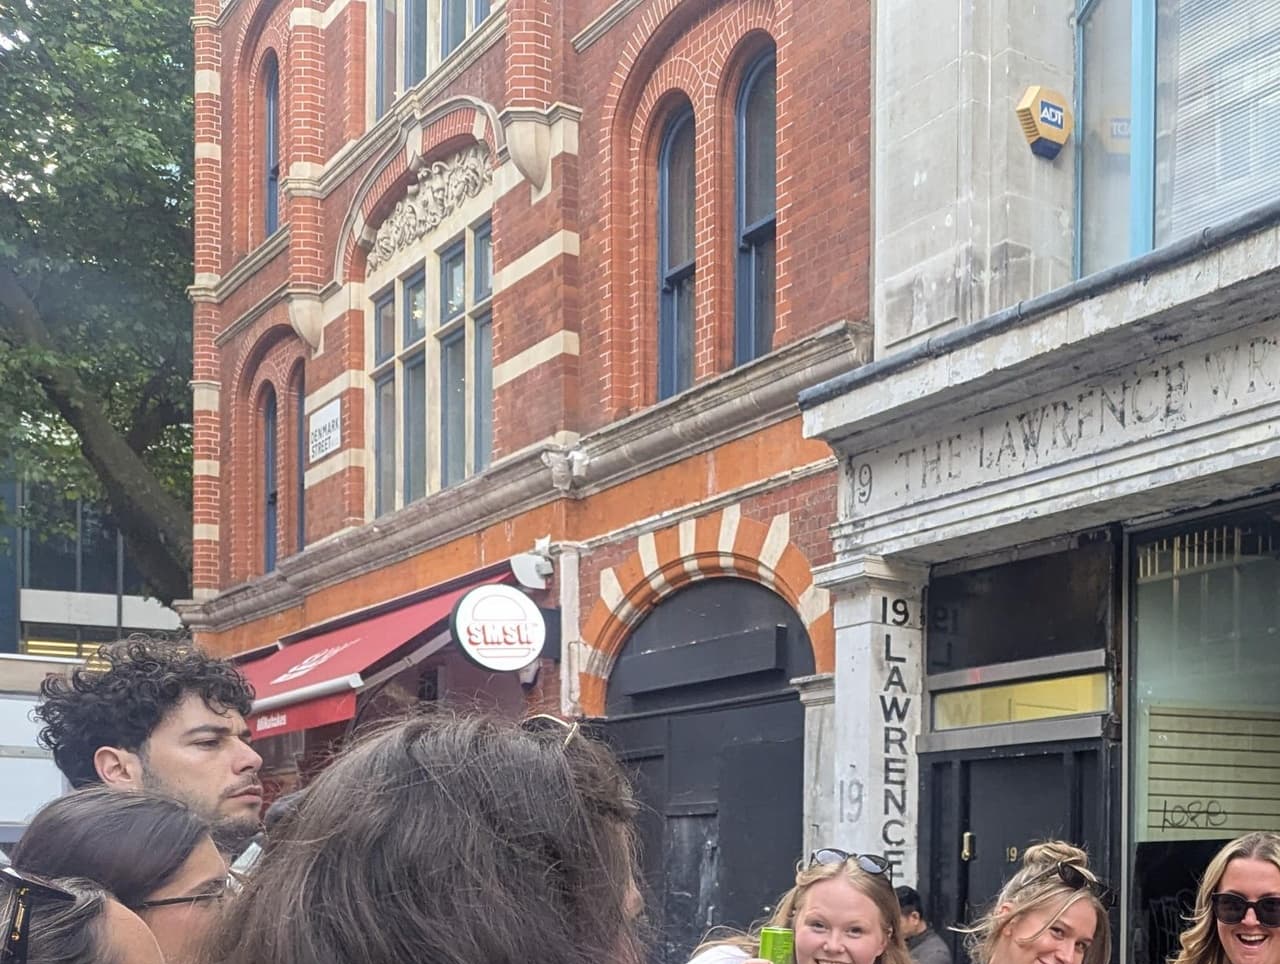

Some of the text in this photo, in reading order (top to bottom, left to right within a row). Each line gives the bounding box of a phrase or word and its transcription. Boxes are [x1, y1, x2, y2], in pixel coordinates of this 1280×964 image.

[1041, 106, 1063, 126] ADT
[311, 416, 340, 446] DENMARK
[896, 434, 961, 494] THE
[978, 361, 1188, 470] LAWRENCE
[311, 434, 332, 459] STREET
[882, 597, 910, 626] 19
[467, 623, 534, 646] SMSH
[880, 634, 912, 879] LAWRENCE
[839, 780, 864, 823] 19
[1006, 846, 1018, 862] 19
